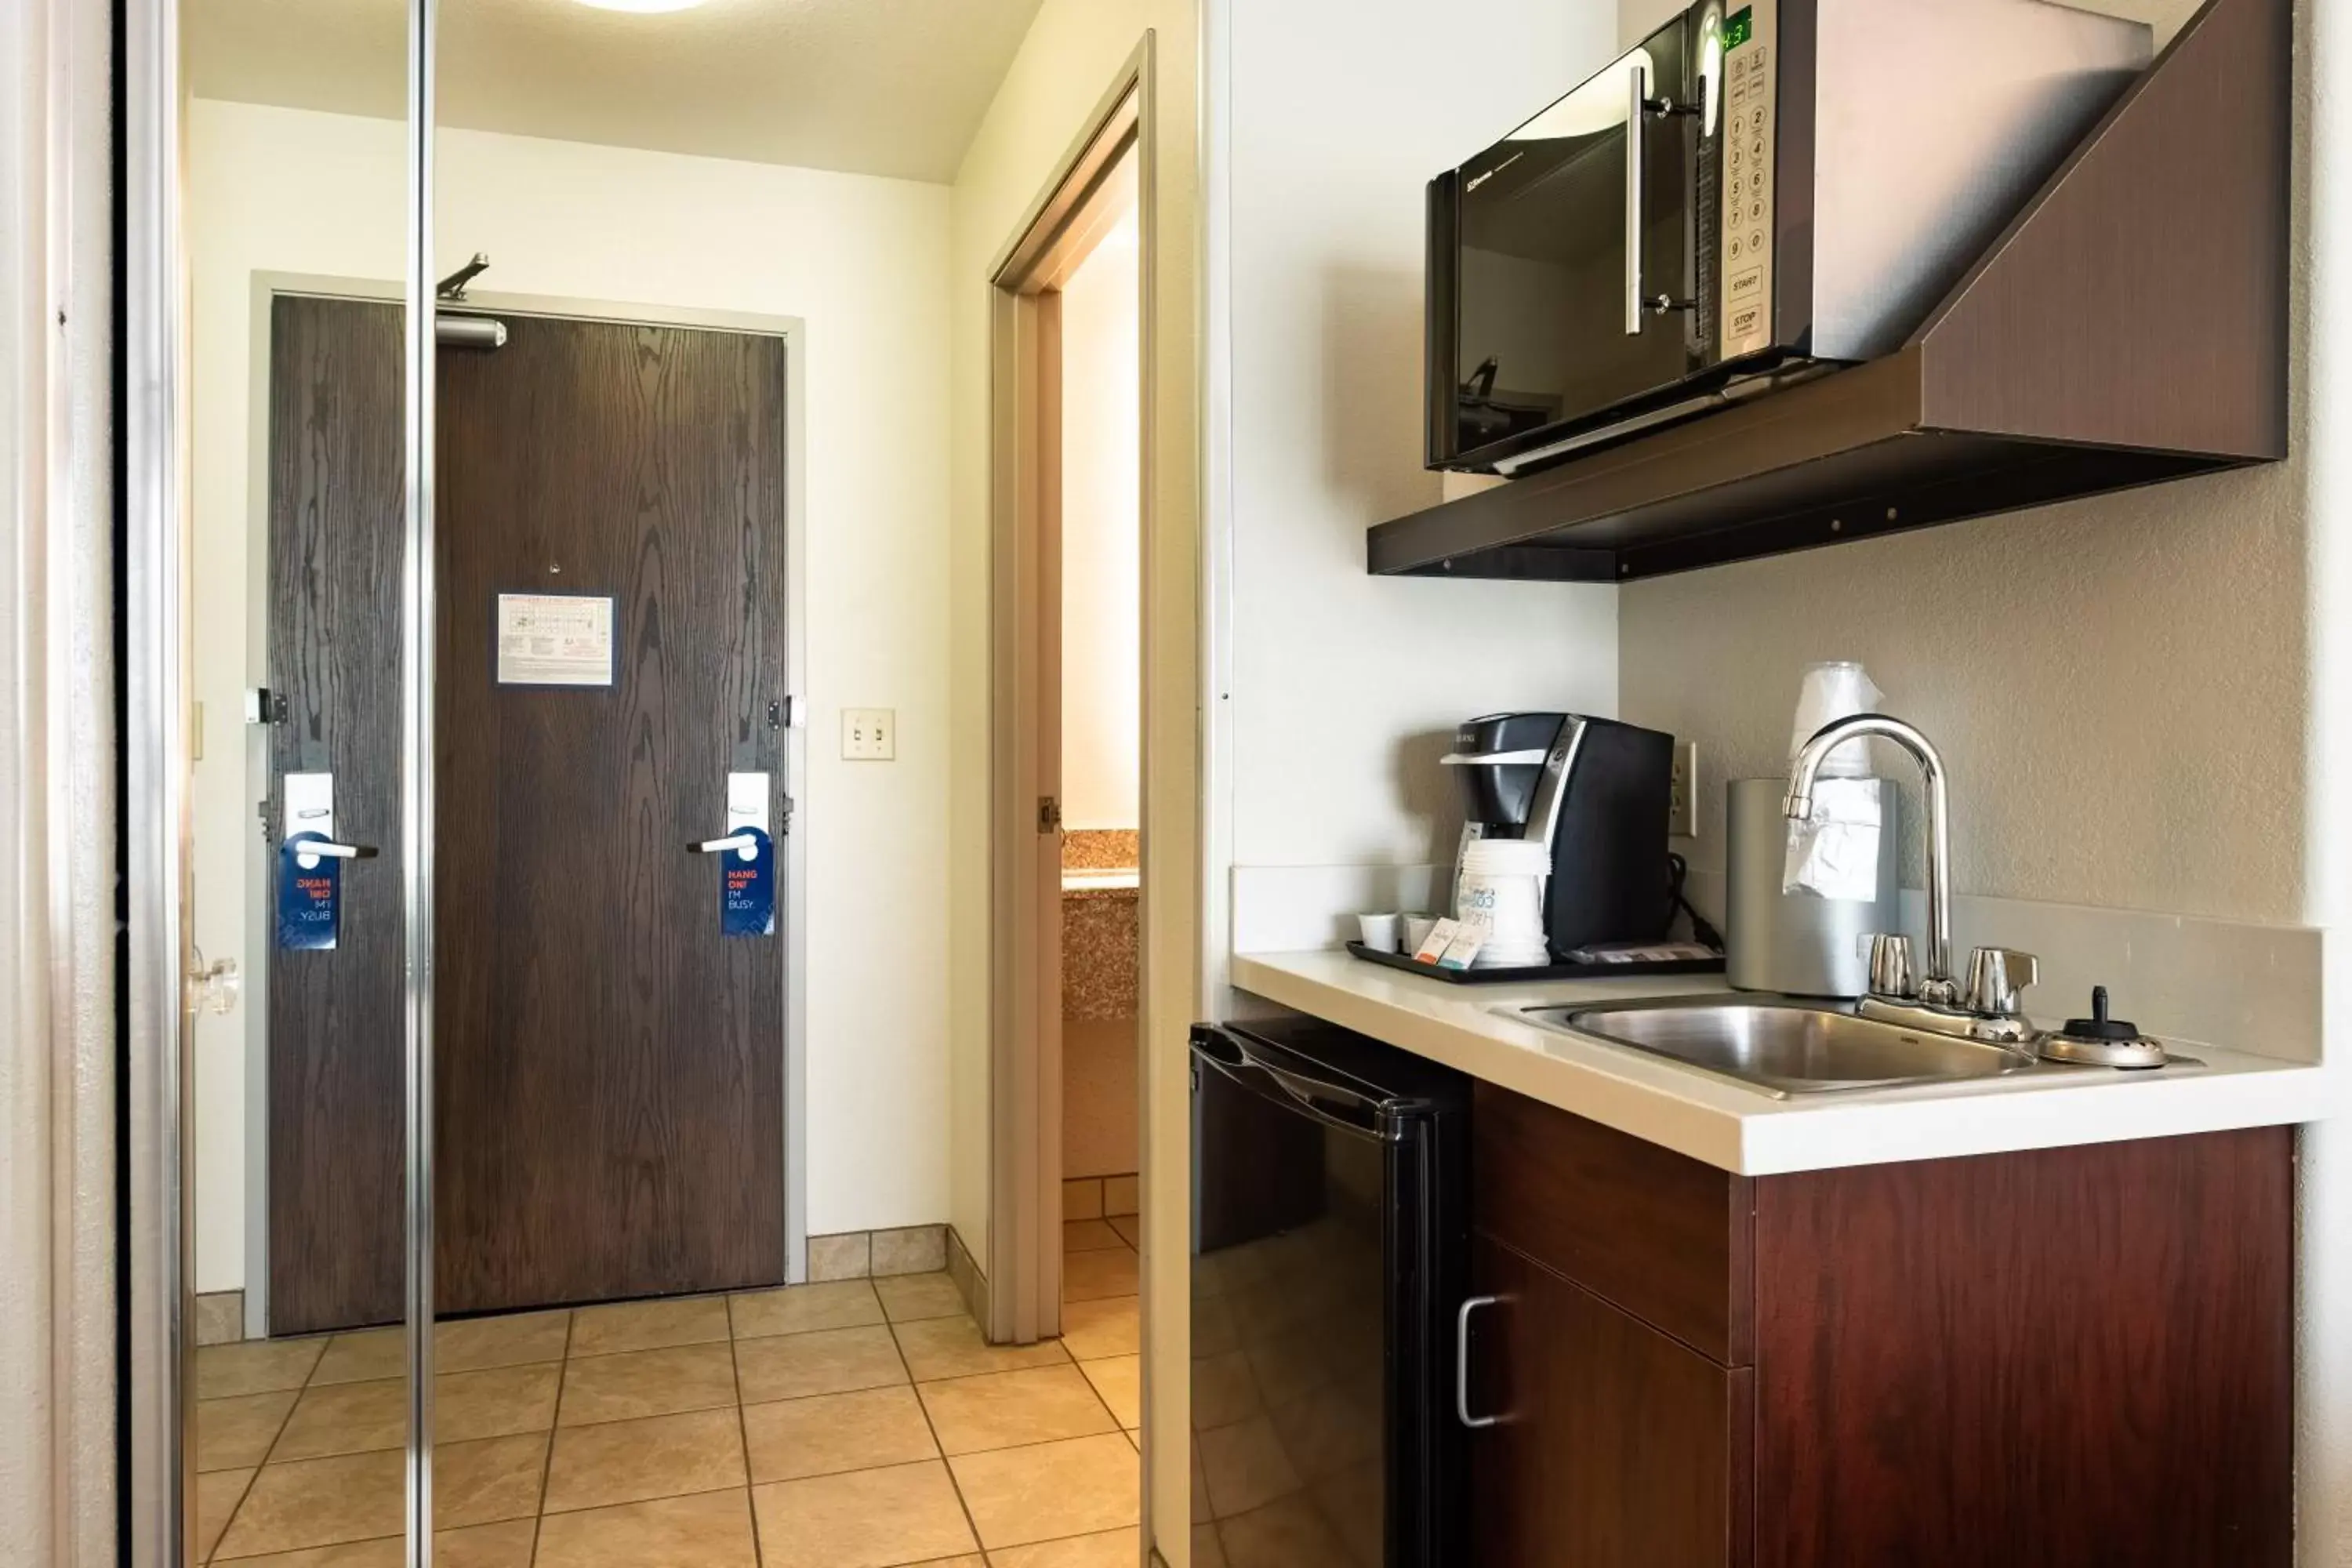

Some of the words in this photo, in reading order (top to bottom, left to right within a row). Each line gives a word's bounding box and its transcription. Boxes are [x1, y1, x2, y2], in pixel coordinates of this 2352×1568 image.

[1733, 275, 1757, 292] START
[1733, 311, 1756, 327] STOP
[728, 869, 758, 879] HANG
[728, 890, 741, 899] I'M
